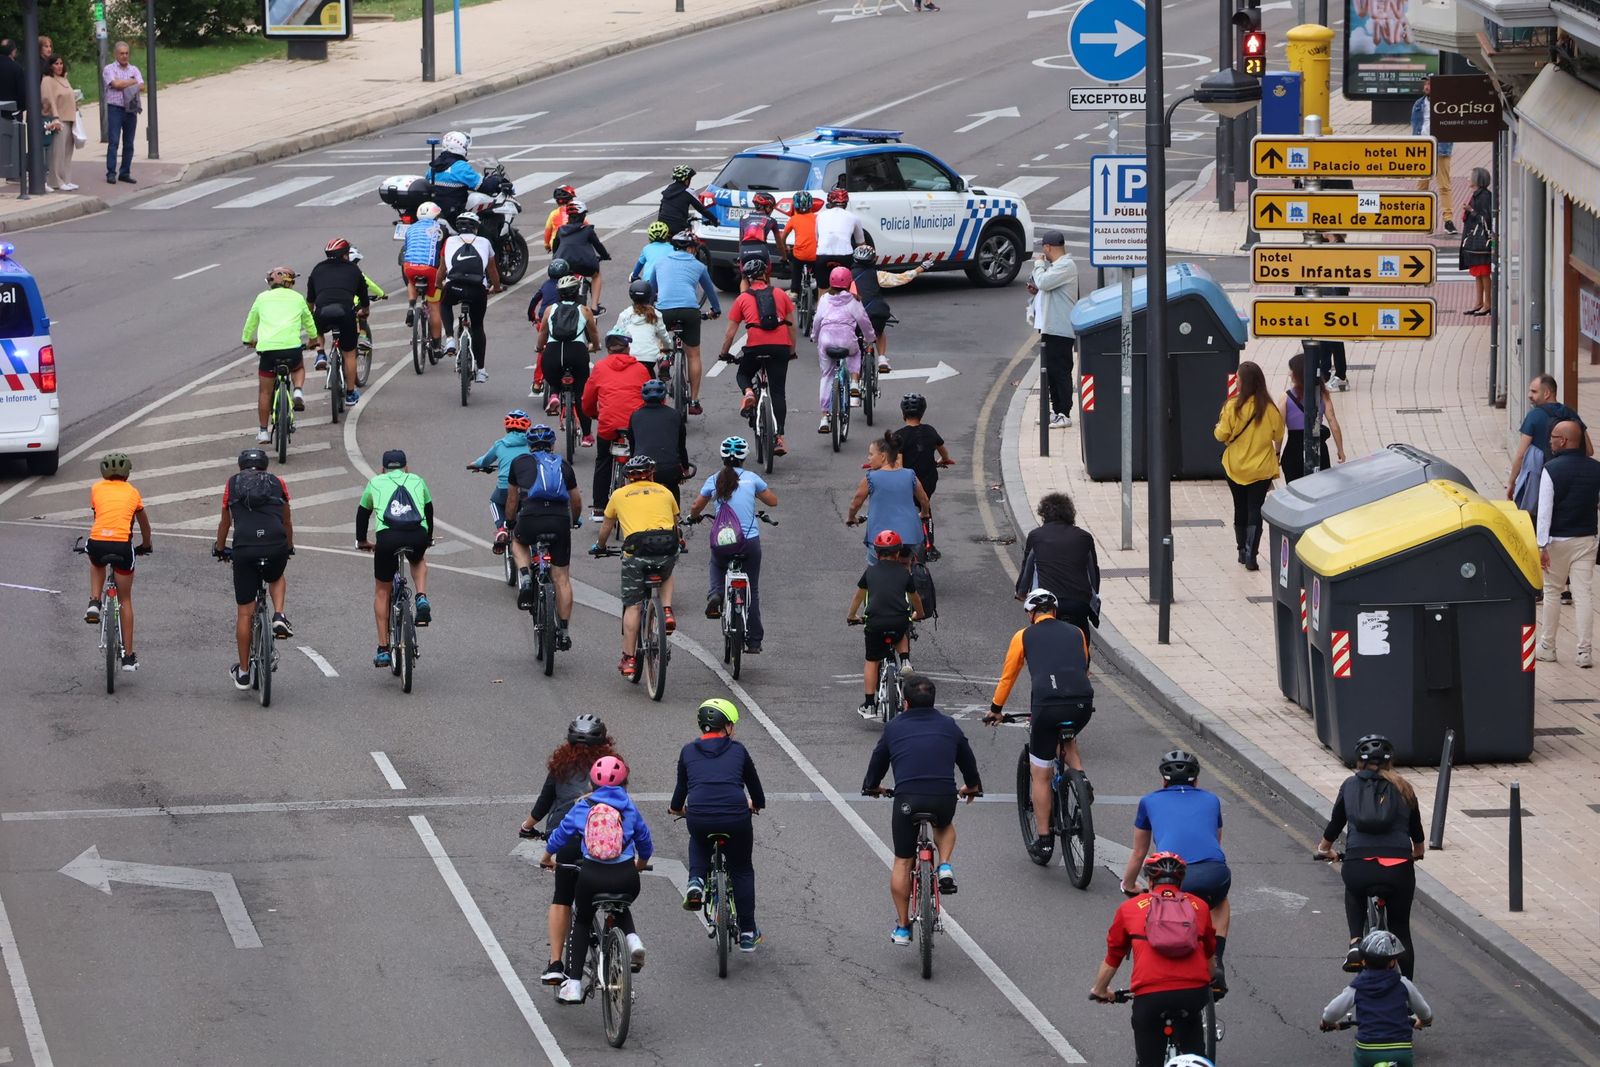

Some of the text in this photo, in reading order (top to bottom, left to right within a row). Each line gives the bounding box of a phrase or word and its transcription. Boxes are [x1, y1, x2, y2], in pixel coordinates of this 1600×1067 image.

[1071, 93, 1147, 104] EXCEPTO BU
[1433, 101, 1495, 117] Cofisa
[1364, 146, 1427, 158] hotel NH
[1313, 161, 1426, 171] Palacio del Duero
[1124, 168, 1147, 199] P
[714, 189, 731, 199] 112
[1114, 205, 1147, 216] PÚBLI
[880, 213, 956, 231] Policía Municipal
[1312, 213, 1425, 225] Real de Zamora
[1260, 253, 1293, 262] hotel
[1260, 265, 1372, 278] Dos Infantas
[1260, 312, 1359, 327] hostal Sol
[5, 394, 37, 403] Informes
